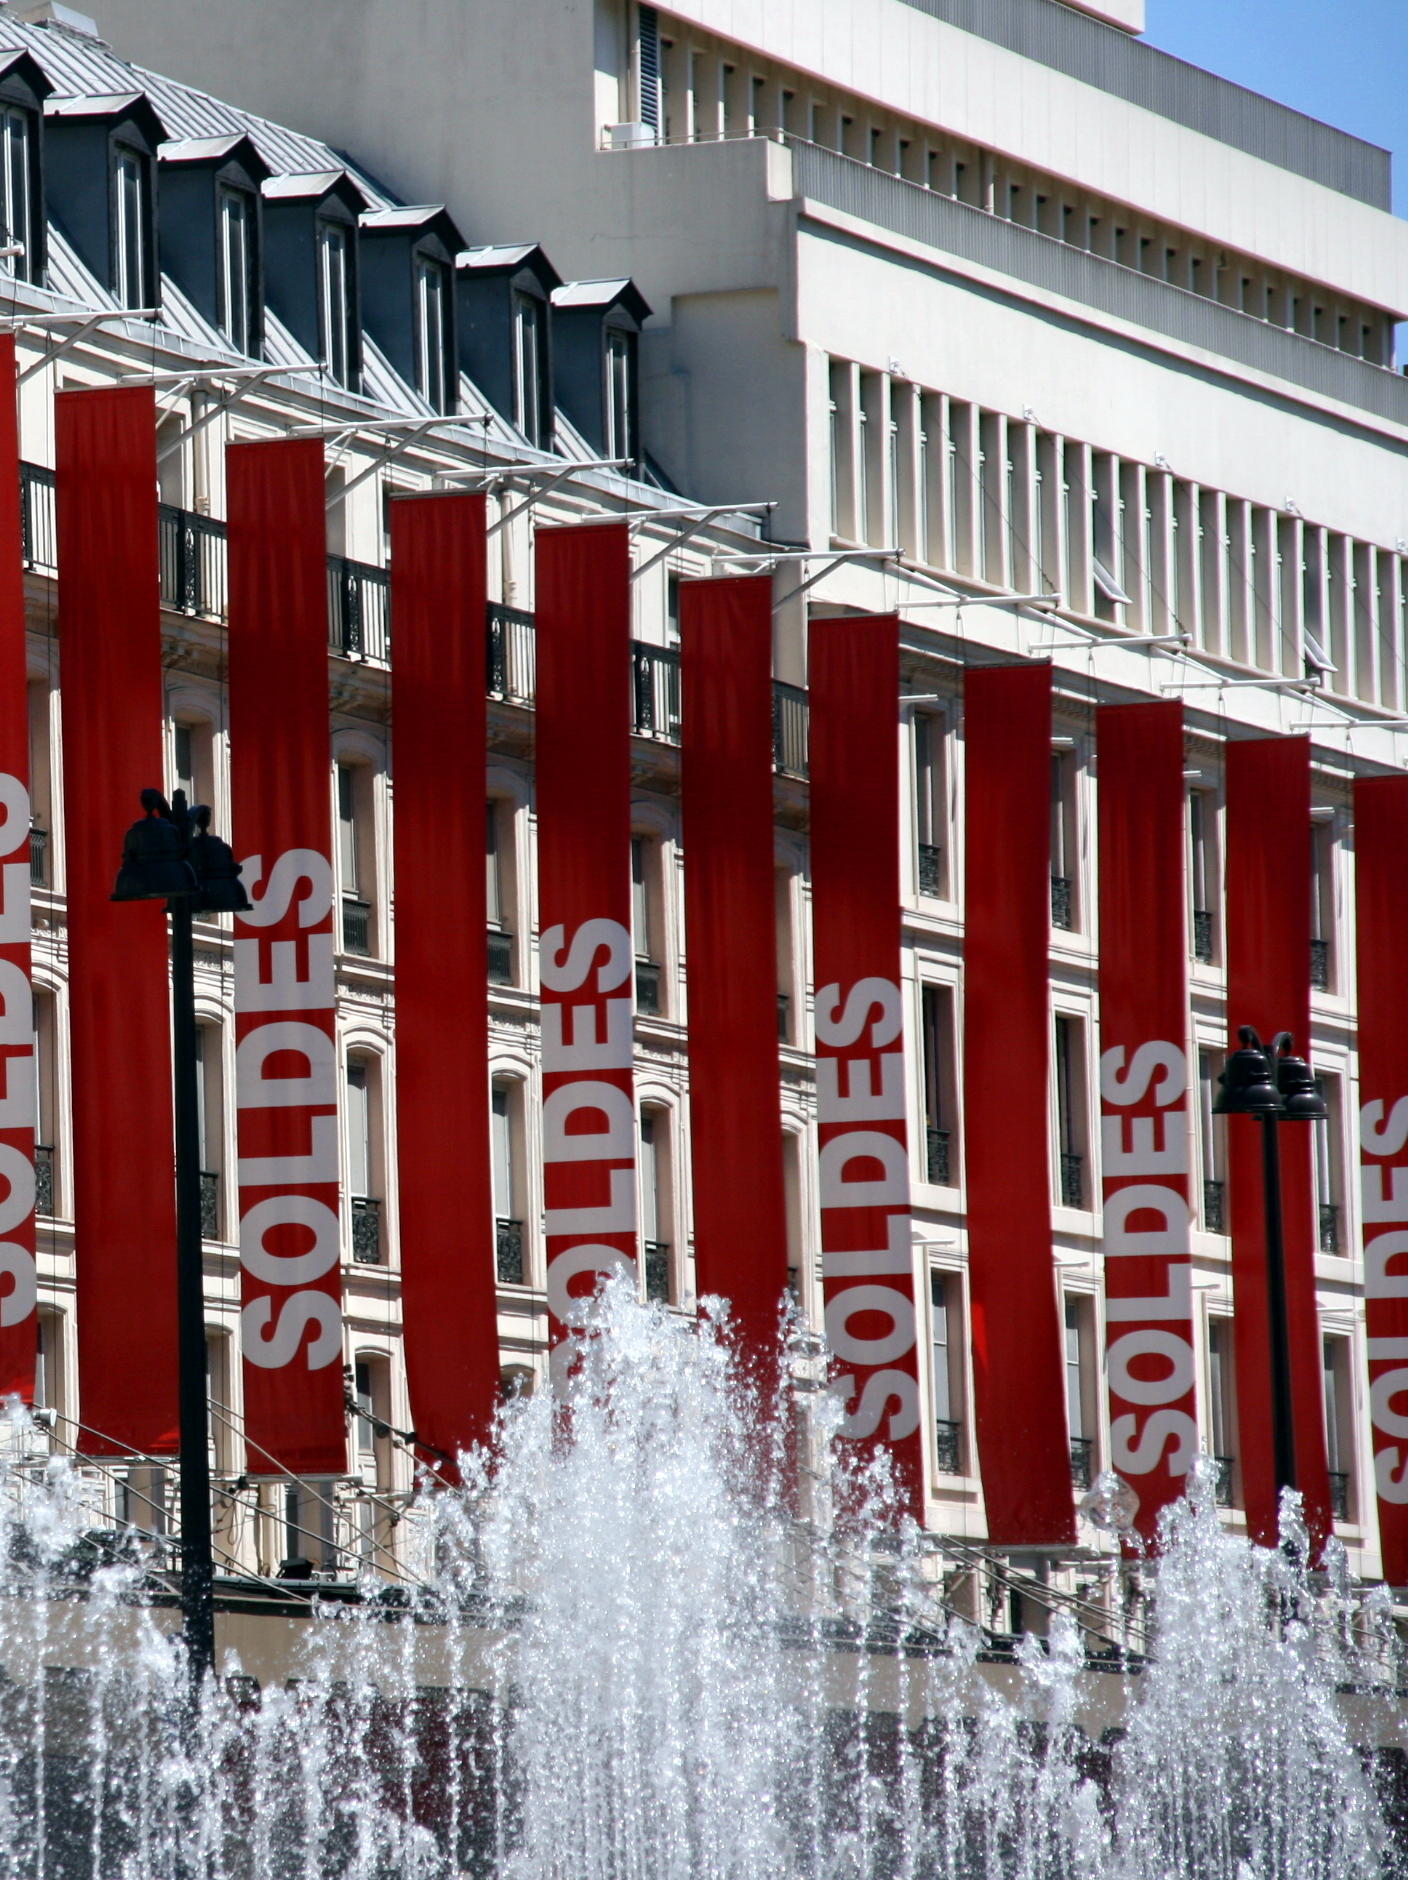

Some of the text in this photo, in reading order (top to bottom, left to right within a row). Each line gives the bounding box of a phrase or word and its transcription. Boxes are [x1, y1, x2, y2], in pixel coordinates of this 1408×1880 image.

[233, 848, 342, 1370] SOLDES
[540, 917, 637, 1402] OLDES
[814, 976, 919, 1440] SOLDES
[1100, 1040, 1198, 1477] SOLDES
